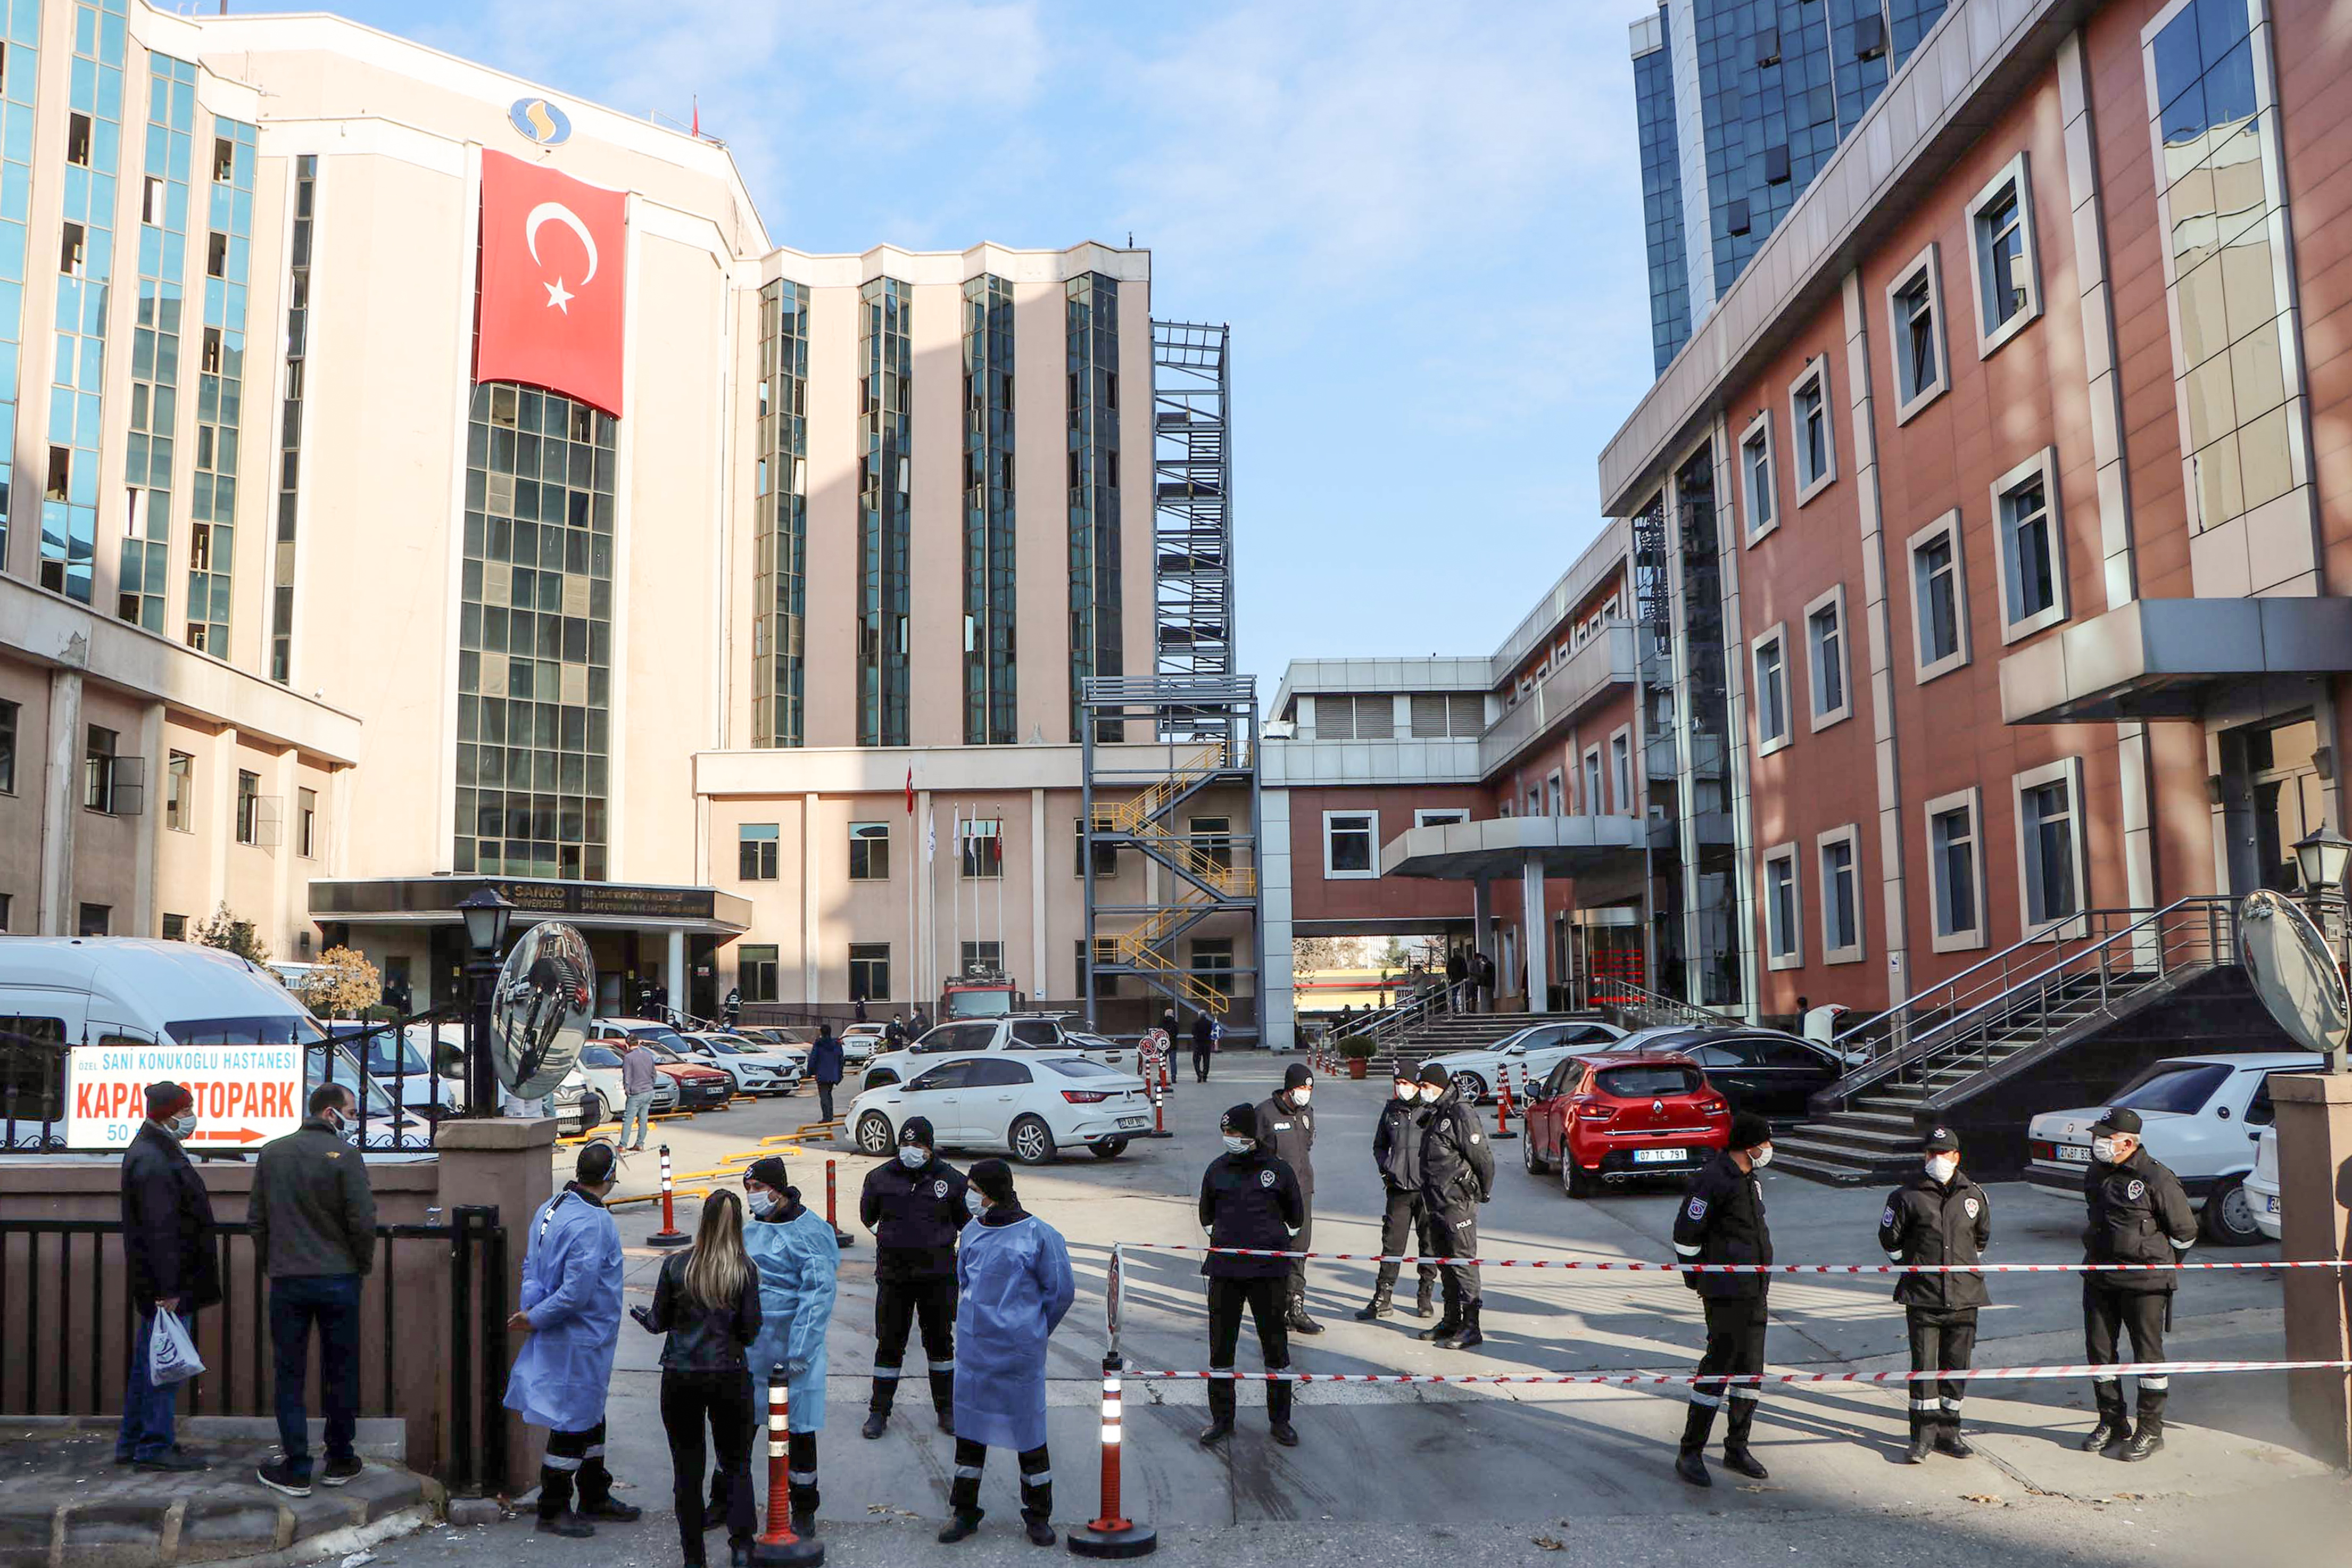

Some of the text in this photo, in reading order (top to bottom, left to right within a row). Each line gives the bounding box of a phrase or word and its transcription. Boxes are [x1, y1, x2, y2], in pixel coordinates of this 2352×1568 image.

[515, 885, 565, 898] SANKO
[79, 1047, 296, 1071] ÖZEL SANİ KONUKOĞLU HASTANESİ
[77, 1082, 152, 1118] KAPA
[107, 1124, 128, 1141] 50
[1640, 1150, 1684, 1160] 07 TC 791
[2061, 1147, 2068, 1157] 27
[2271, 1198, 2279, 1211] 34
